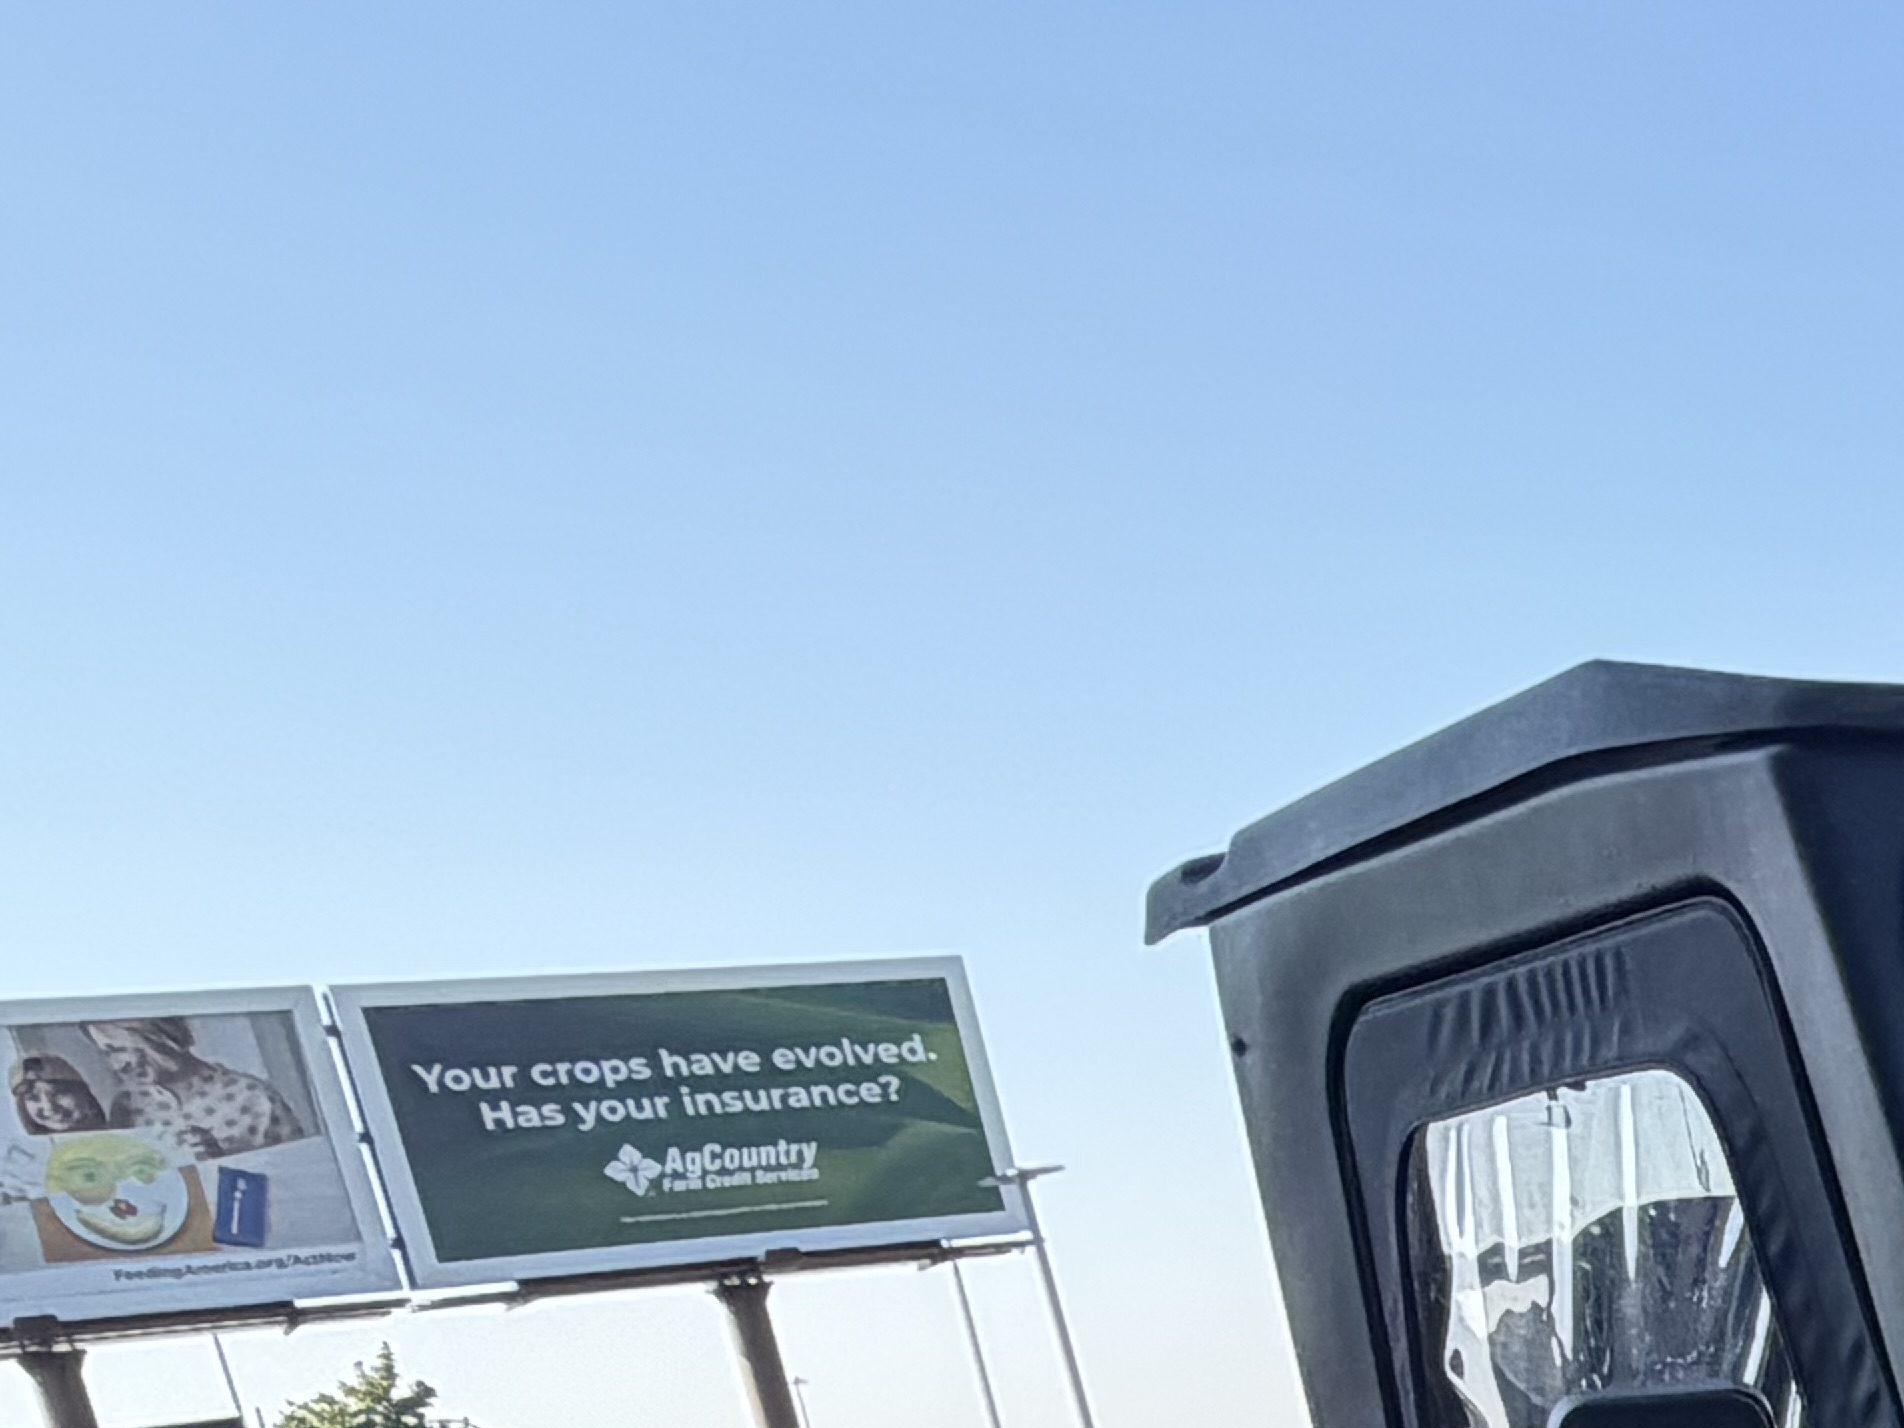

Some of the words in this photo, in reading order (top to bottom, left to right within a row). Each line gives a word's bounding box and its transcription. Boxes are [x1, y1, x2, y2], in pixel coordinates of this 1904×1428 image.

[411, 1063, 517, 1094] Your
[530, 1056, 652, 1088] crops
[658, 1048, 761, 1077] have
[771, 1033, 937, 1071] evolved.
[479, 1100, 566, 1131] Has
[572, 1096, 670, 1132] your
[679, 1075, 901, 1117] insurance?
[664, 1138, 818, 1179] AgCountry
